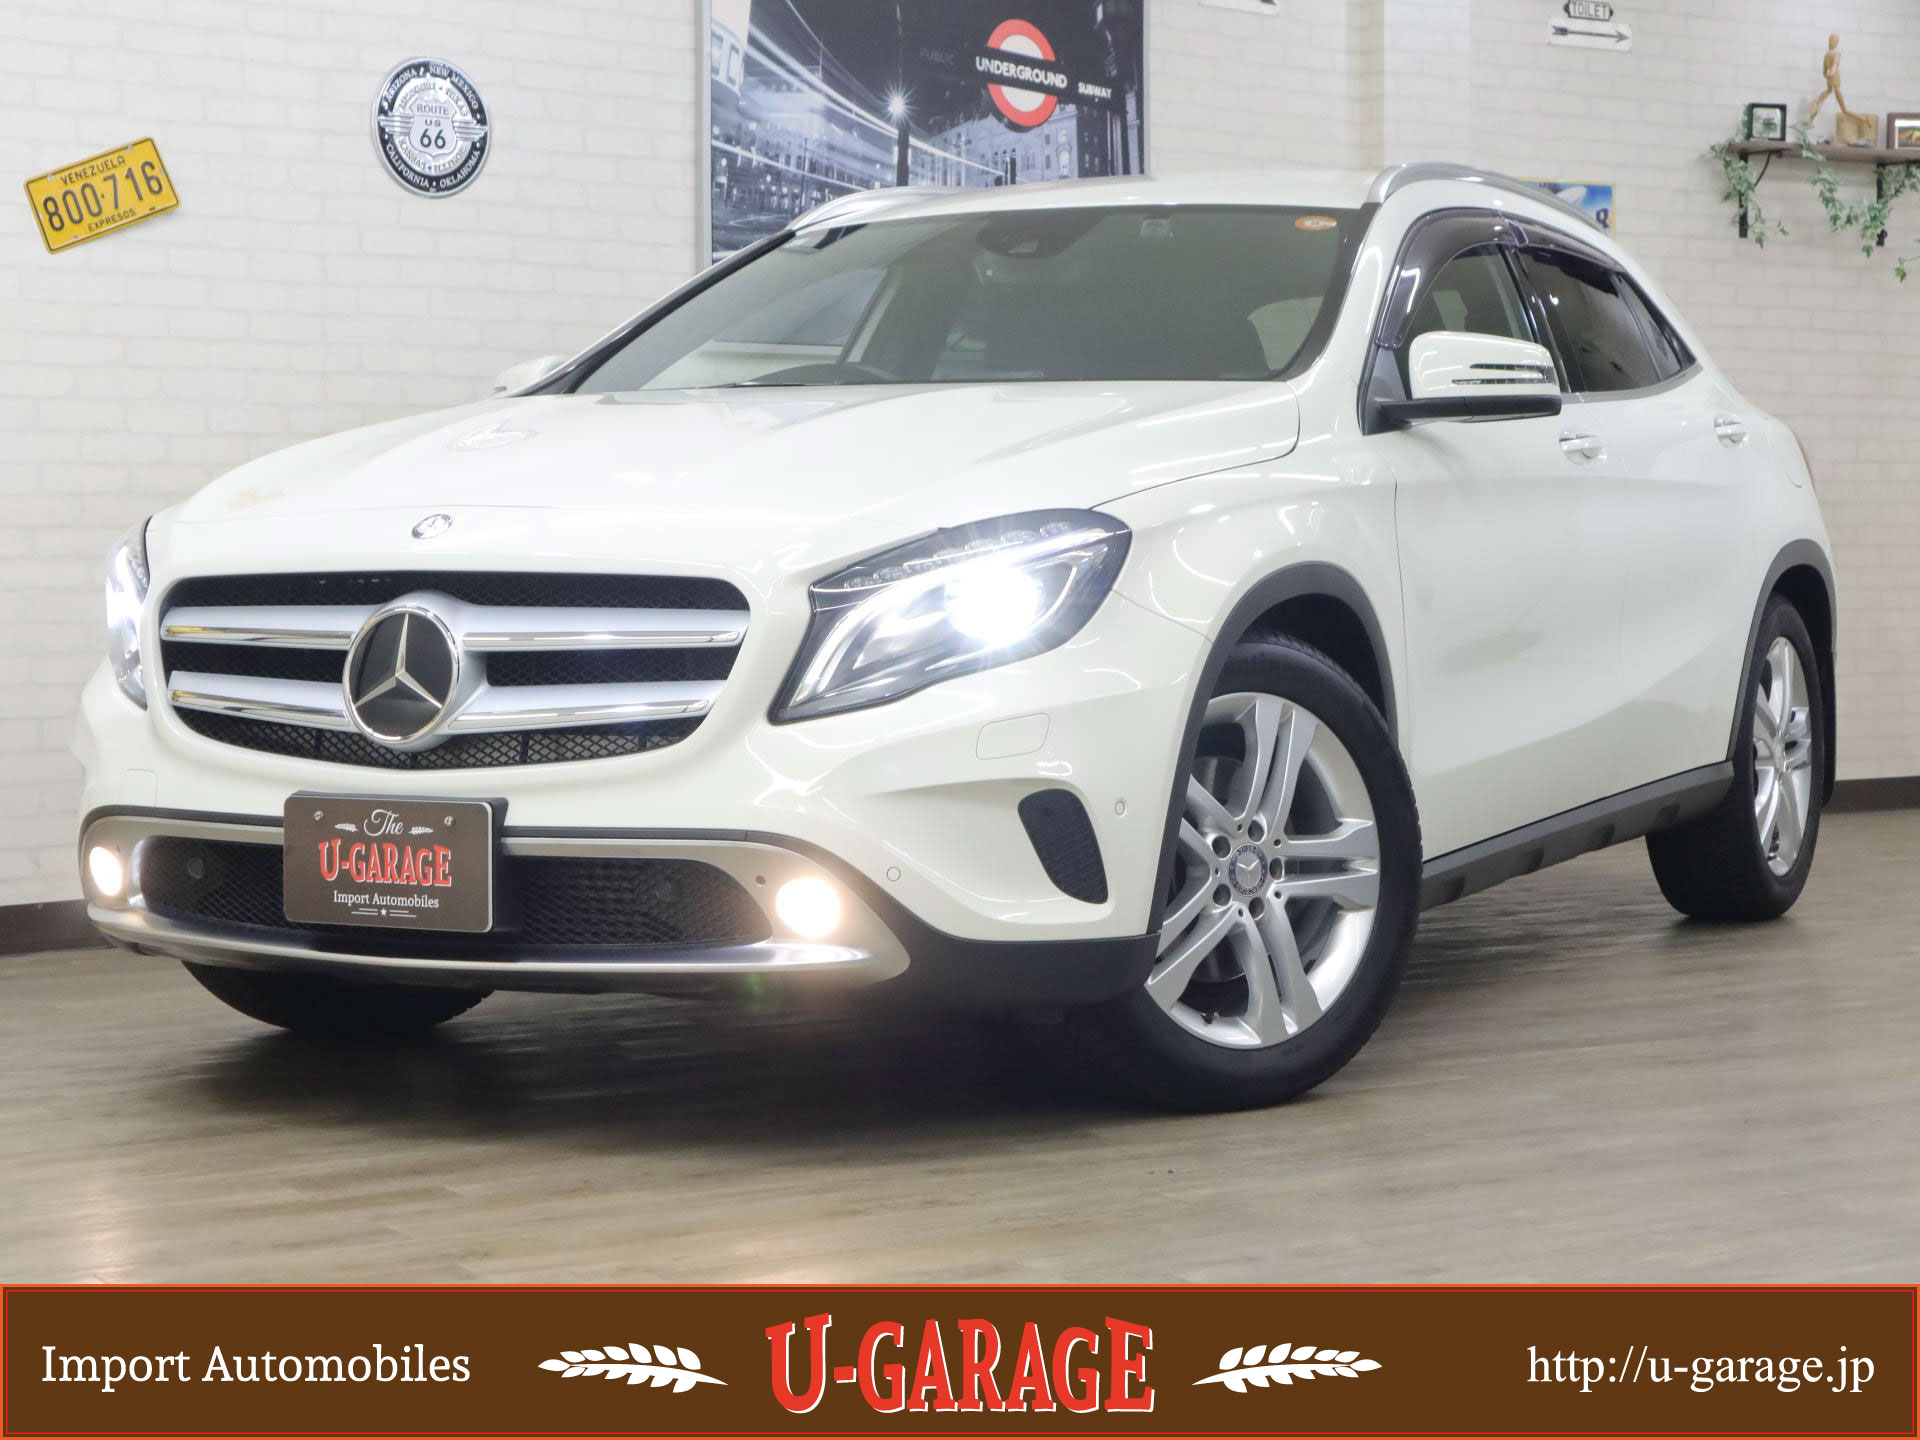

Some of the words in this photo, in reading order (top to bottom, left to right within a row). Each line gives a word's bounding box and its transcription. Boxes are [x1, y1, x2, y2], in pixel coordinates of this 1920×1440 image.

[1571, 2, 1608, 18] TOILET
[386, 68, 417, 103] ARIZONA
[430, 64, 450, 78] NEW
[451, 71, 479, 110] MEXICO
[976, 56, 1067, 88] UNDERGROUND
[1078, 82, 1112, 99] SUBWAY
[416, 103, 449, 116] ROUTE
[425, 119, 441, 127] US
[420, 127, 446, 149] 66
[60, 155, 126, 185] VENEZUELA
[386, 143, 429, 188] CALIFORNIA
[440, 151, 480, 188] OKLAHOMA
[88, 208, 136, 231] EXPRESOS
[363, 808, 404, 837] The
[318, 838, 452, 887] U-GARAGE
[333, 890, 370, 906] Import
[371, 893, 439, 908] Automobiles
